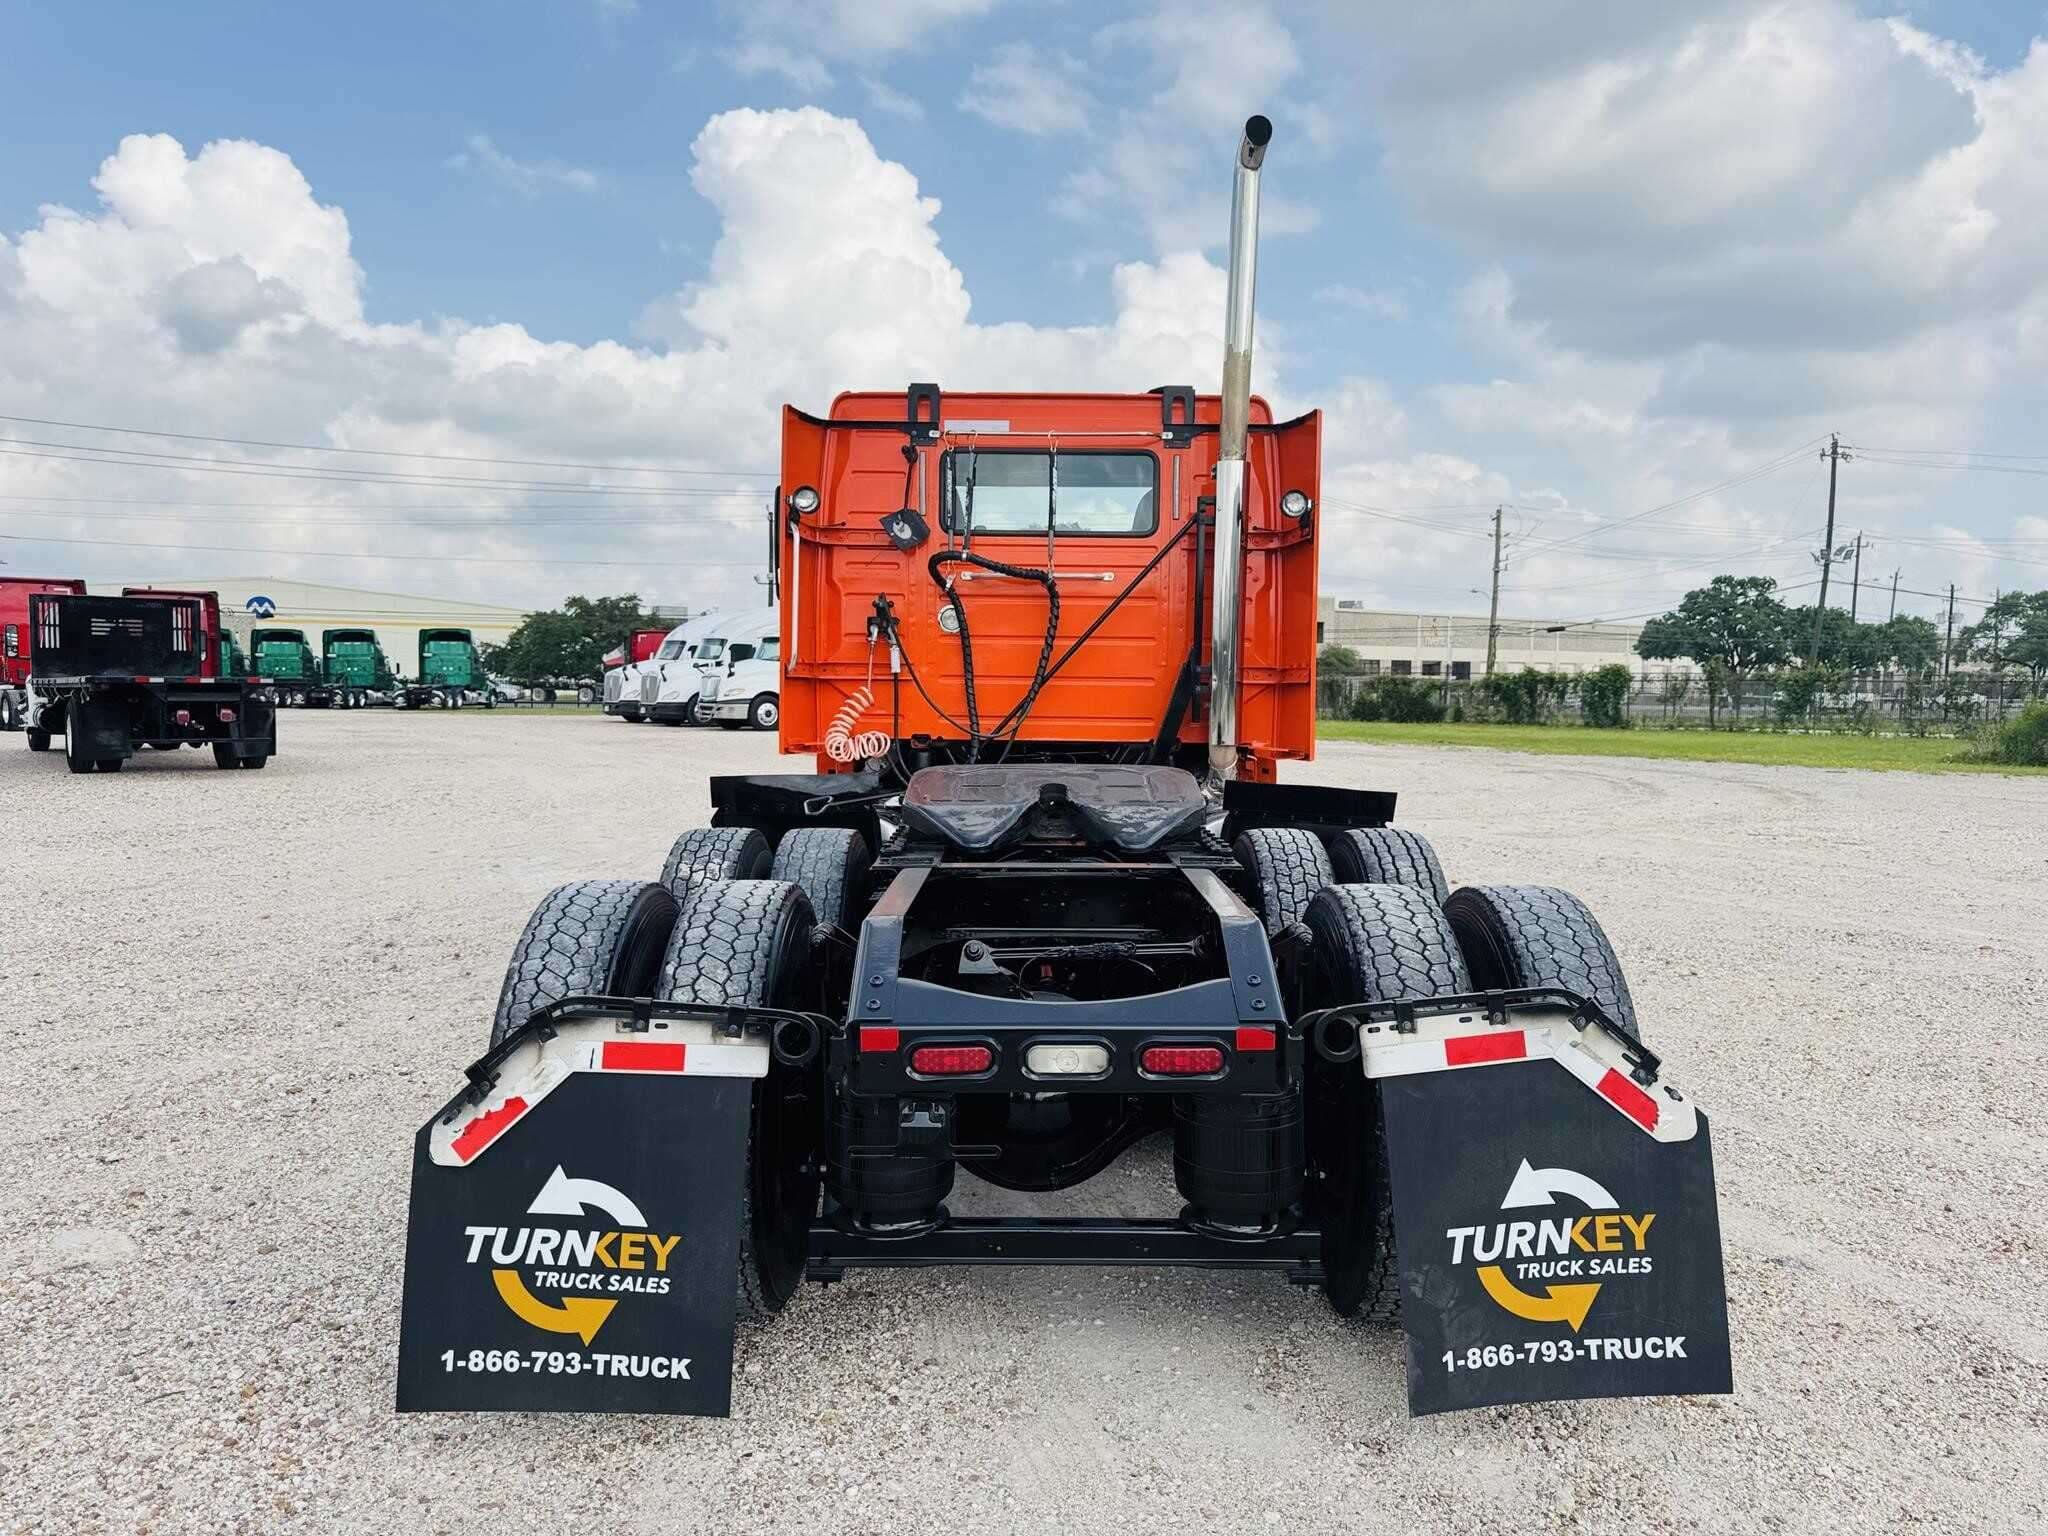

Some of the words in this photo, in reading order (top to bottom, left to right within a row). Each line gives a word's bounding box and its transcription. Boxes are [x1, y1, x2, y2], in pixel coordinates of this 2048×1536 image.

[464, 1225, 682, 1272] TURNKEY
[1446, 1213, 1657, 1264] TURNKEY
[534, 1270, 605, 1291] TRUCK
[606, 1274, 671, 1295] SALES
[1516, 1259, 1585, 1280] TRUCK
[1588, 1256, 1653, 1276] SALES
[440, 1349, 692, 1381] 1-866-793-TRUCK
[1441, 1336, 1688, 1373] 1-866-793-TRUCK
